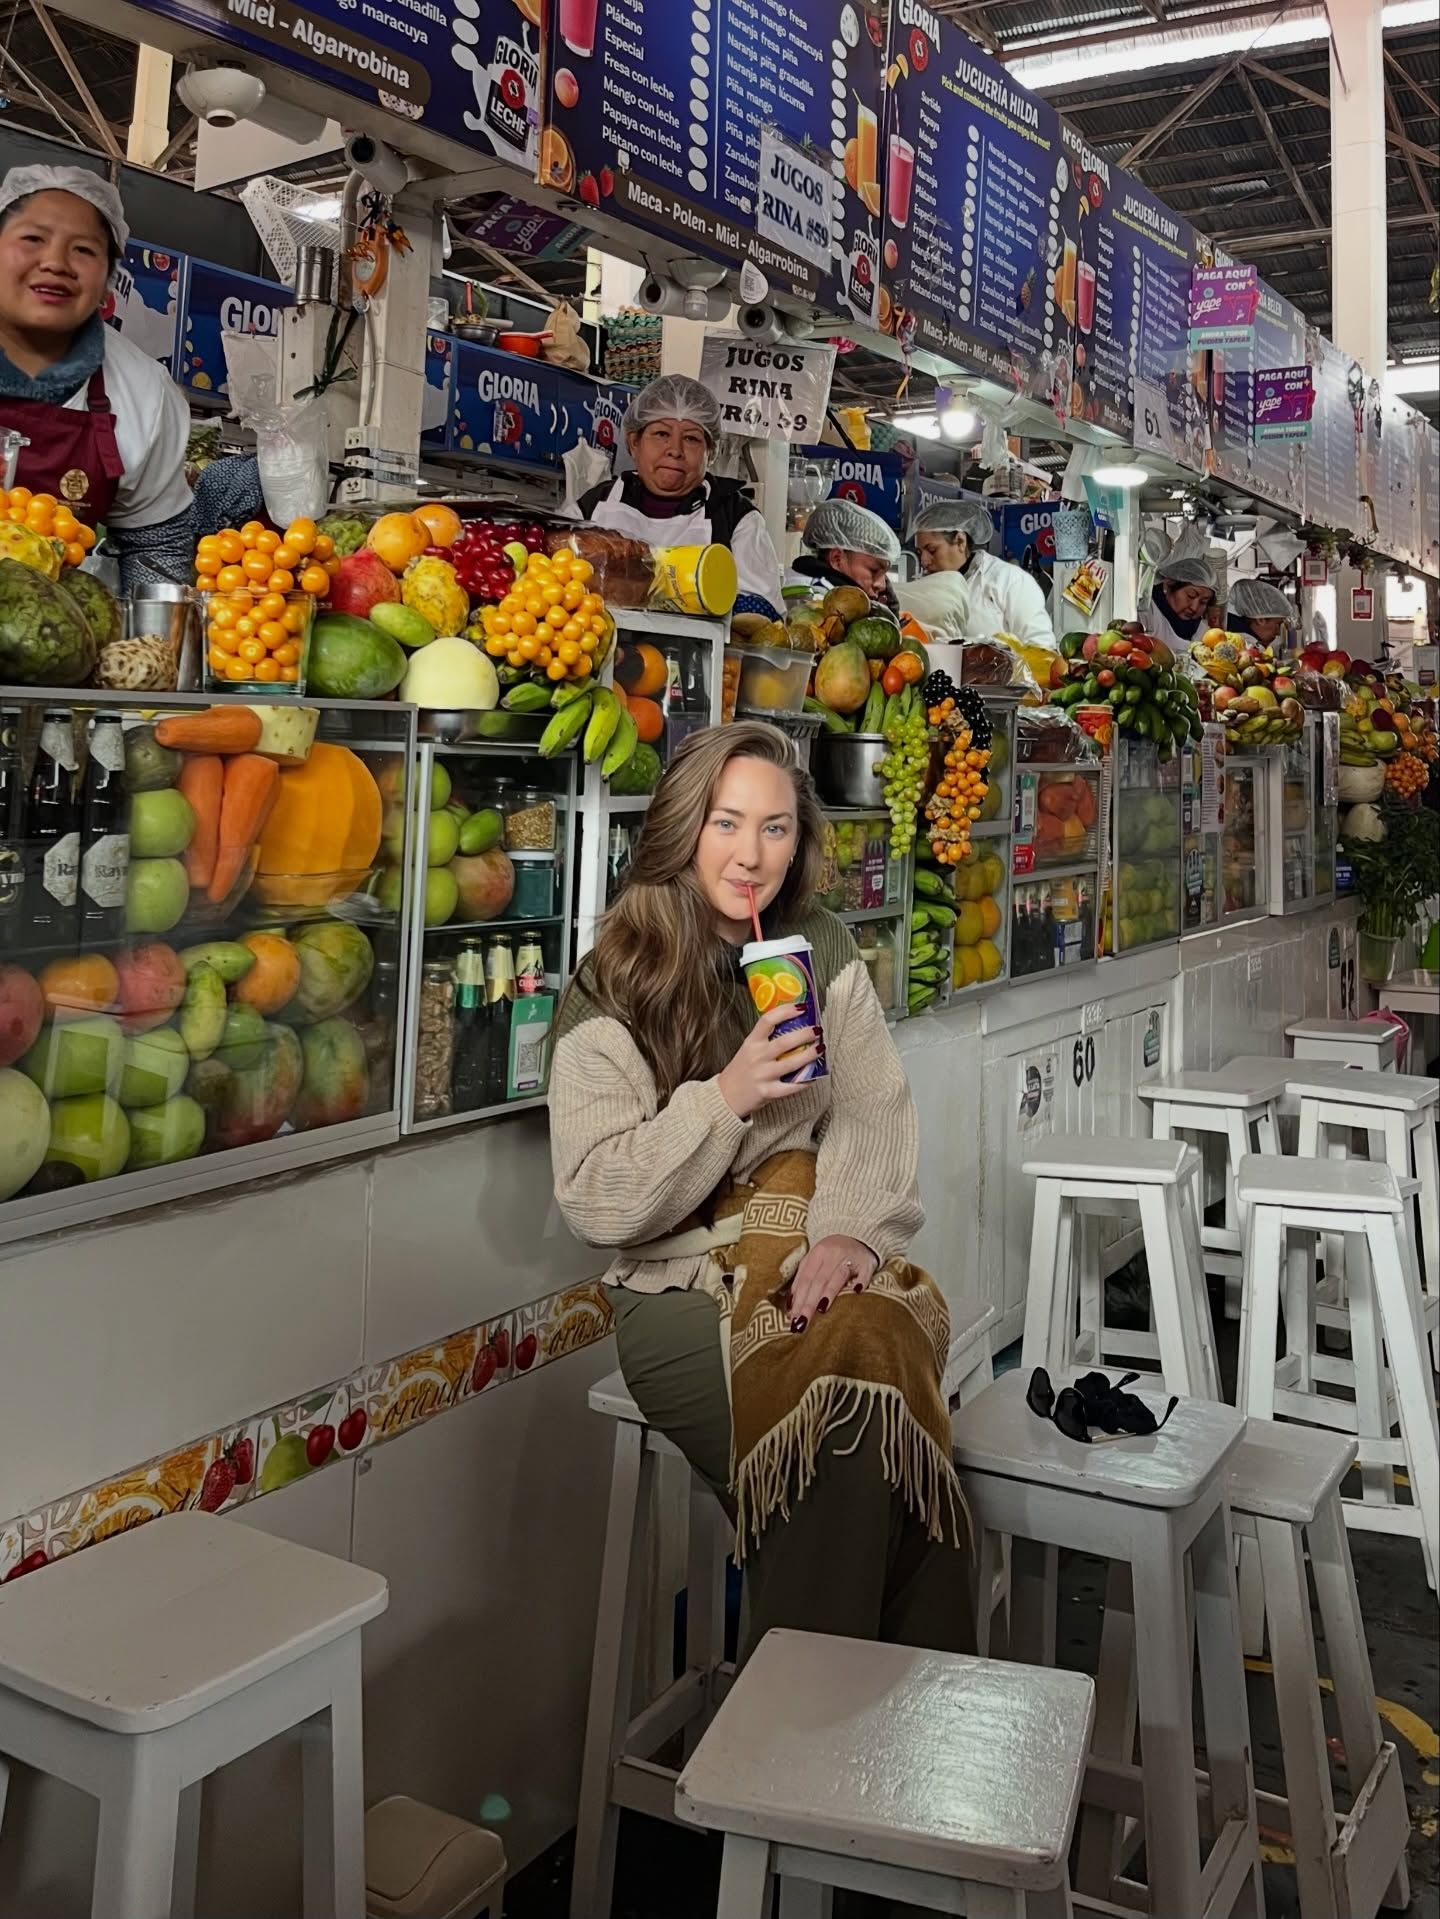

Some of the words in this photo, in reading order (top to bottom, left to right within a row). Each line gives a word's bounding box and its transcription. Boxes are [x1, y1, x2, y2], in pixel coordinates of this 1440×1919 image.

[362, 3, 428, 44] maracuya
[605, 3, 643, 36] Plátano
[788, 8, 808, 31] fresa
[898, 0, 940, 54] GLORIA
[227, 0, 275, 29] Miel
[292, 18, 410, 88] Algarrobina
[605, 27, 644, 61] Especial
[727, 10, 758, 40] Naranja
[760, 32, 780, 54] fresa
[782, 48, 799, 67] piña
[761, 13, 786, 37] mango
[788, 32, 823, 63] maracuyá
[495, 40, 539, 96] GLORIA
[604, 52, 631, 78] Fresa
[632, 70, 649, 88] con
[650, 77, 675, 102] leche
[727, 32, 758, 61] Naranja
[760, 56, 777, 73] piña
[778, 68, 814, 97] granadilla
[726, 54, 758, 83] Naranja
[760, 77, 777, 95] piña
[778, 85, 806, 112] lúcuma
[726, 75, 745, 97] Piña
[746, 90, 773, 114] mango
[955, 58, 1009, 110] JUGUERÍA
[1009, 93, 1039, 129] HILDA
[490, 96, 526, 135] LECHE
[603, 75, 636, 106] Mango
[638, 97, 655, 115] con
[656, 104, 680, 129] leche
[725, 98, 744, 119] Piña
[920, 91, 941, 114] Surtido
[603, 100, 639, 131] Papaya
[639, 124, 657, 141] con
[658, 129, 682, 153] leche
[725, 121, 743, 142] Piña
[919, 108, 940, 132] Papaya
[602, 125, 640, 156] Plátano
[641, 148, 658, 166] con
[659, 155, 684, 178] leche
[917, 146, 933, 166] Fresa
[918, 128, 938, 150] Mango
[725, 143, 760, 173] Zanahori
[1081, 147, 1110, 191] GLORIA
[725, 166, 758, 193] Zanahor
[771, 154, 823, 206] JUGOS
[916, 165, 938, 188] Naranja
[628, 181, 662, 213] Maca
[673, 203, 706, 233] Polen
[716, 222, 740, 249] Miel
[748, 239, 808, 281] Algarrobina
[761, 190, 803, 238] RINA
[806, 217, 829, 248] #59
[1123, 194, 1160, 231] JUGUERÍA
[1160, 217, 1179, 242] FANY
[851, 277, 872, 304] LECHE
[1196, 271, 1224, 281] PAGA
[1225, 267, 1252, 279] AQUÍ
[1225, 282, 1246, 291] CON
[1193, 297, 1222, 321] yape
[923, 319, 943, 342] Maca
[948, 332, 968, 354] Polen
[973, 344, 988, 363] Miel
[725, 346, 805, 372] JUGOS
[1259, 372, 1283, 381] PAGA
[1284, 368, 1308, 379] AQUÍ
[478, 369, 541, 416] GLORIA
[728, 375, 793, 400] RINA
[1285, 381, 1303, 390] CON
[1144, 408, 1161, 439] 61
[1256, 396, 1282, 418] yape
[834, 458, 885, 491] LORIA
[1020, 513, 1052, 535] GLO
[1073, 1036, 1096, 1088] 60
